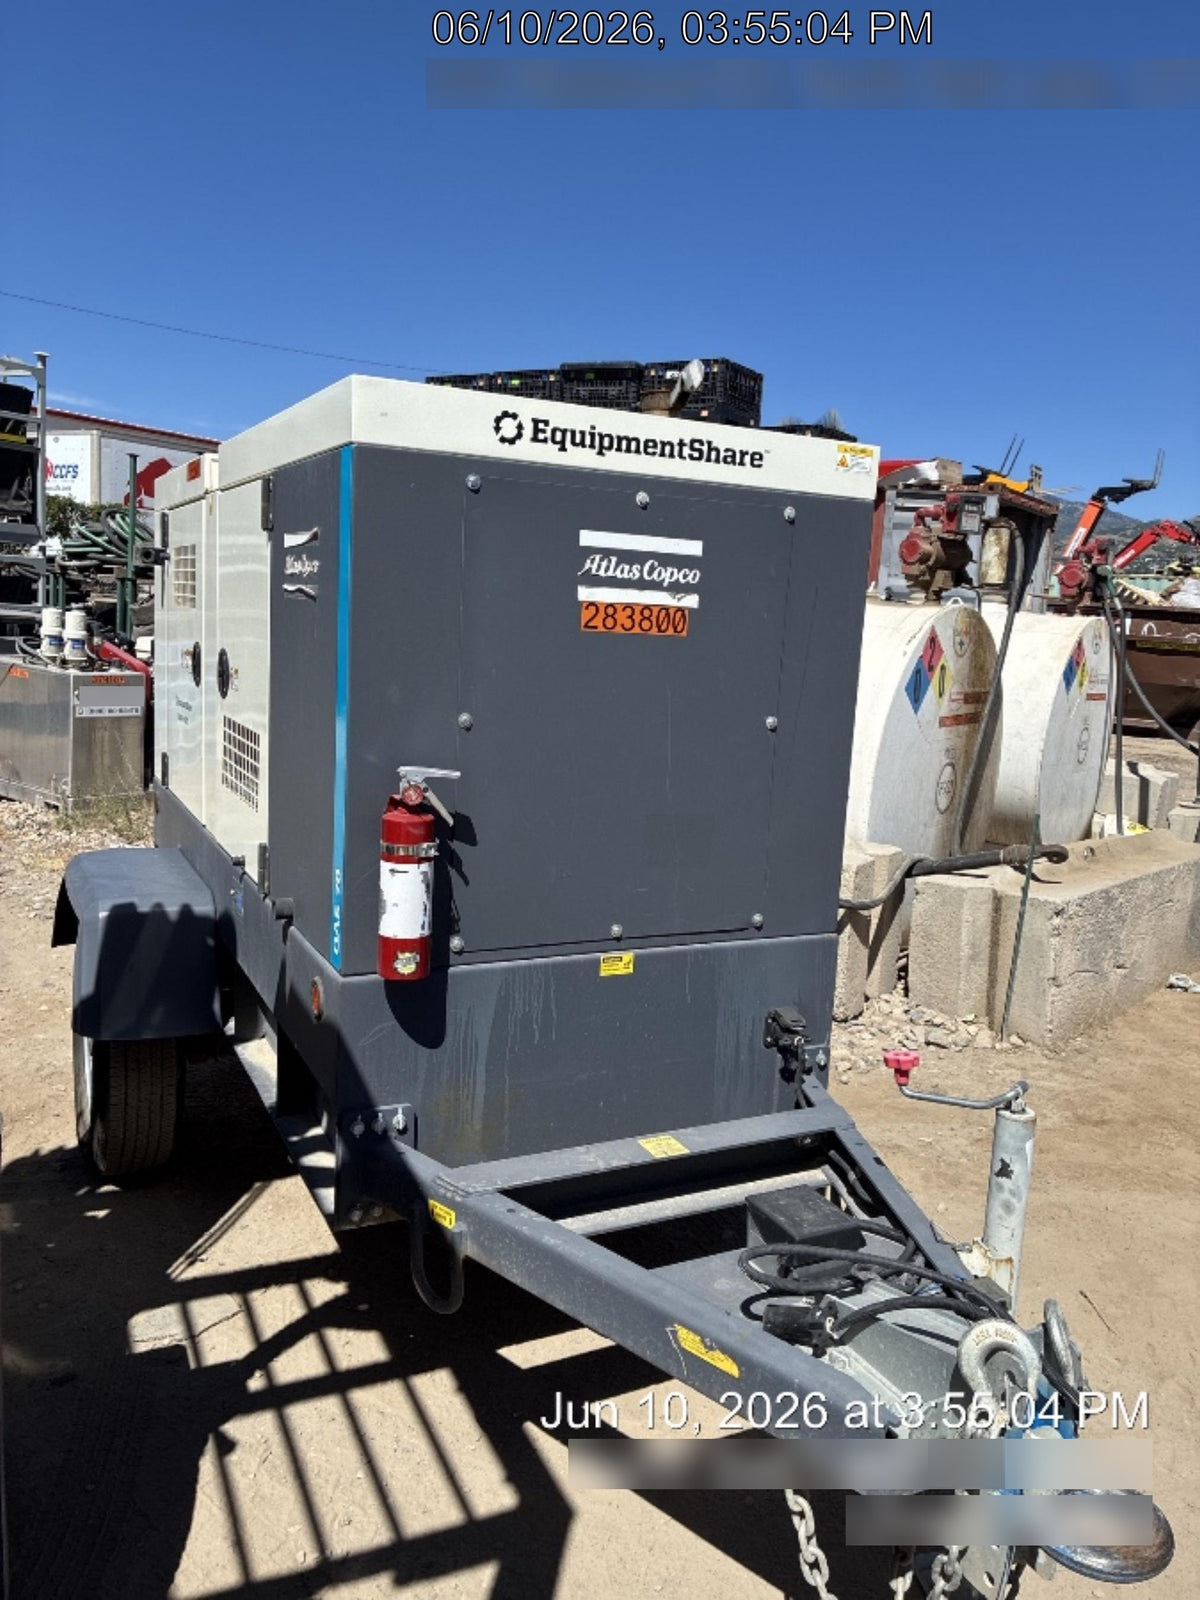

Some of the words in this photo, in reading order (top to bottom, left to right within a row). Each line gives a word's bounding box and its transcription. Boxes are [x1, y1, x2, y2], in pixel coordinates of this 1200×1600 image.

[530, 417, 764, 469] EquipmentShare
[578, 553, 641, 582] Atlas
[643, 558, 701, 587] Copco
[581, 603, 688, 634] 283800
[927, 636, 936, 673] 2
